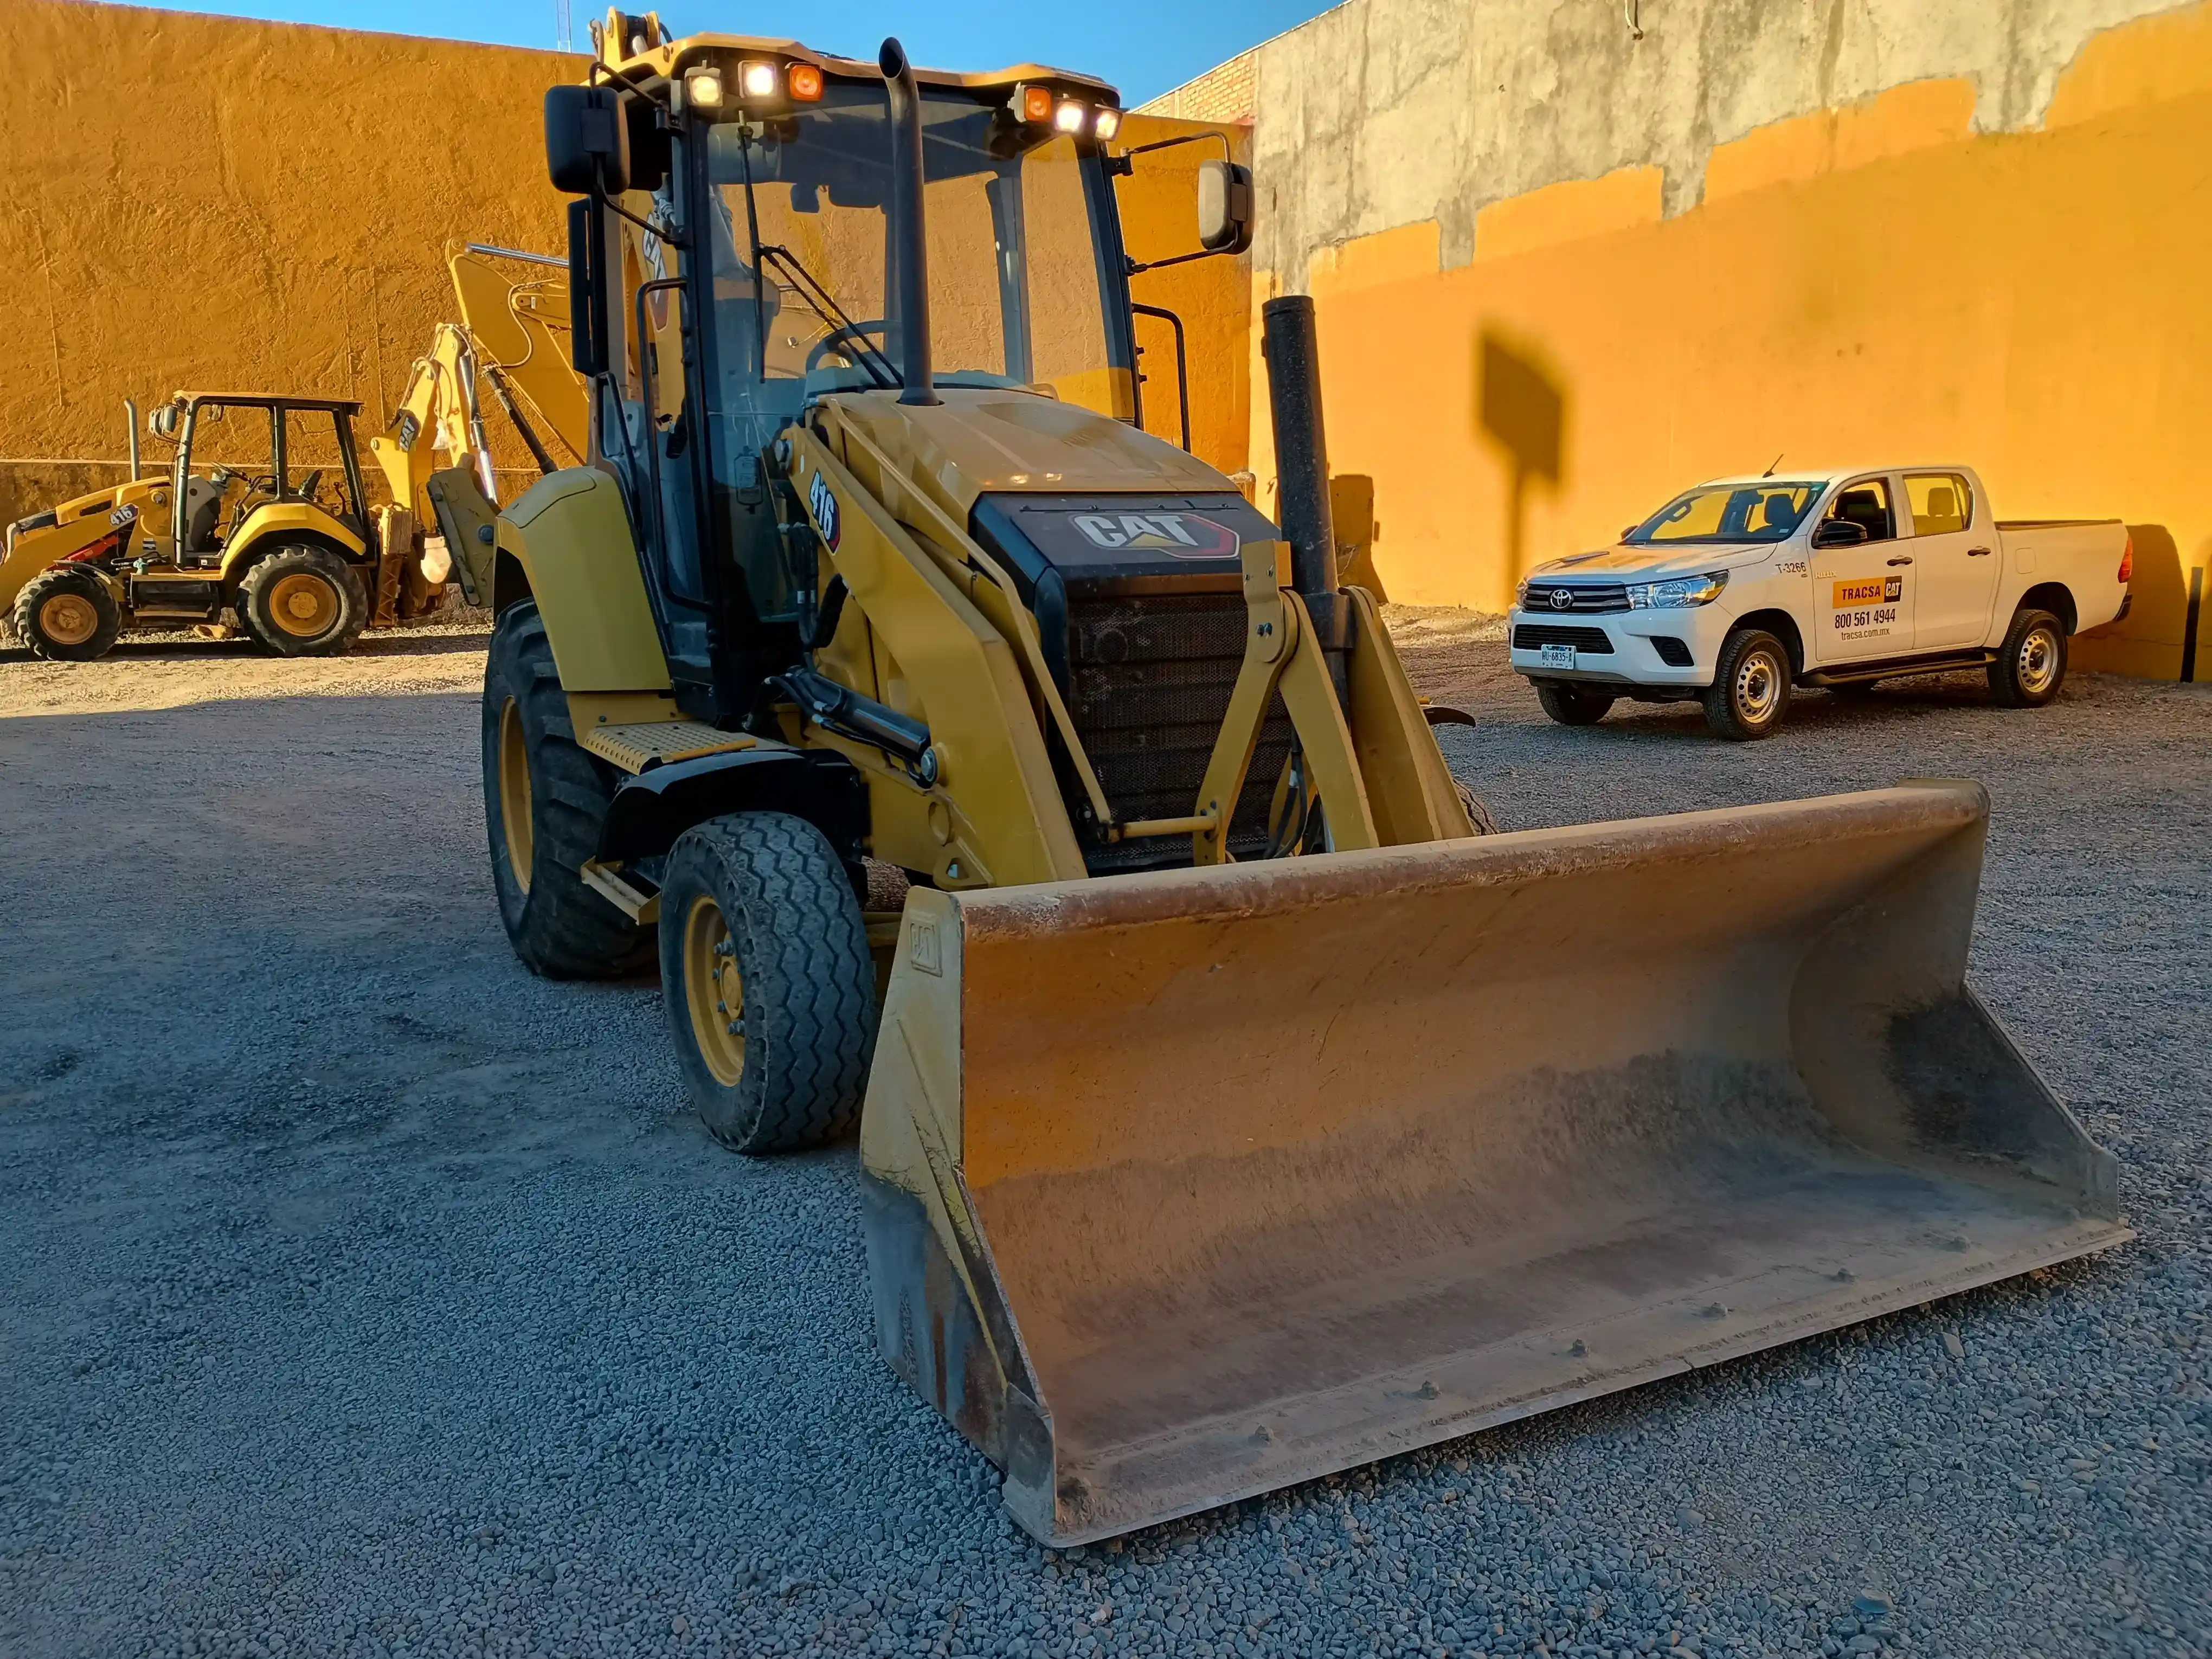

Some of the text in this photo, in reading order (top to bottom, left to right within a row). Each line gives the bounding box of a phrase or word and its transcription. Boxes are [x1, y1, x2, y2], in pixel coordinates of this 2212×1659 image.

[398, 416, 415, 452] CAT
[810, 471, 834, 540] 416
[110, 507, 133, 525] 416
[1074, 516, 1199, 548] CAT
[1775, 562, 1807, 574] T-3266
[1842, 586, 1881, 601] TRACSA
[1885, 582, 1901, 597] CAT
[1835, 608, 1895, 629] 800 561 4944
[1841, 628, 1891, 641] tracsa.com.mx
